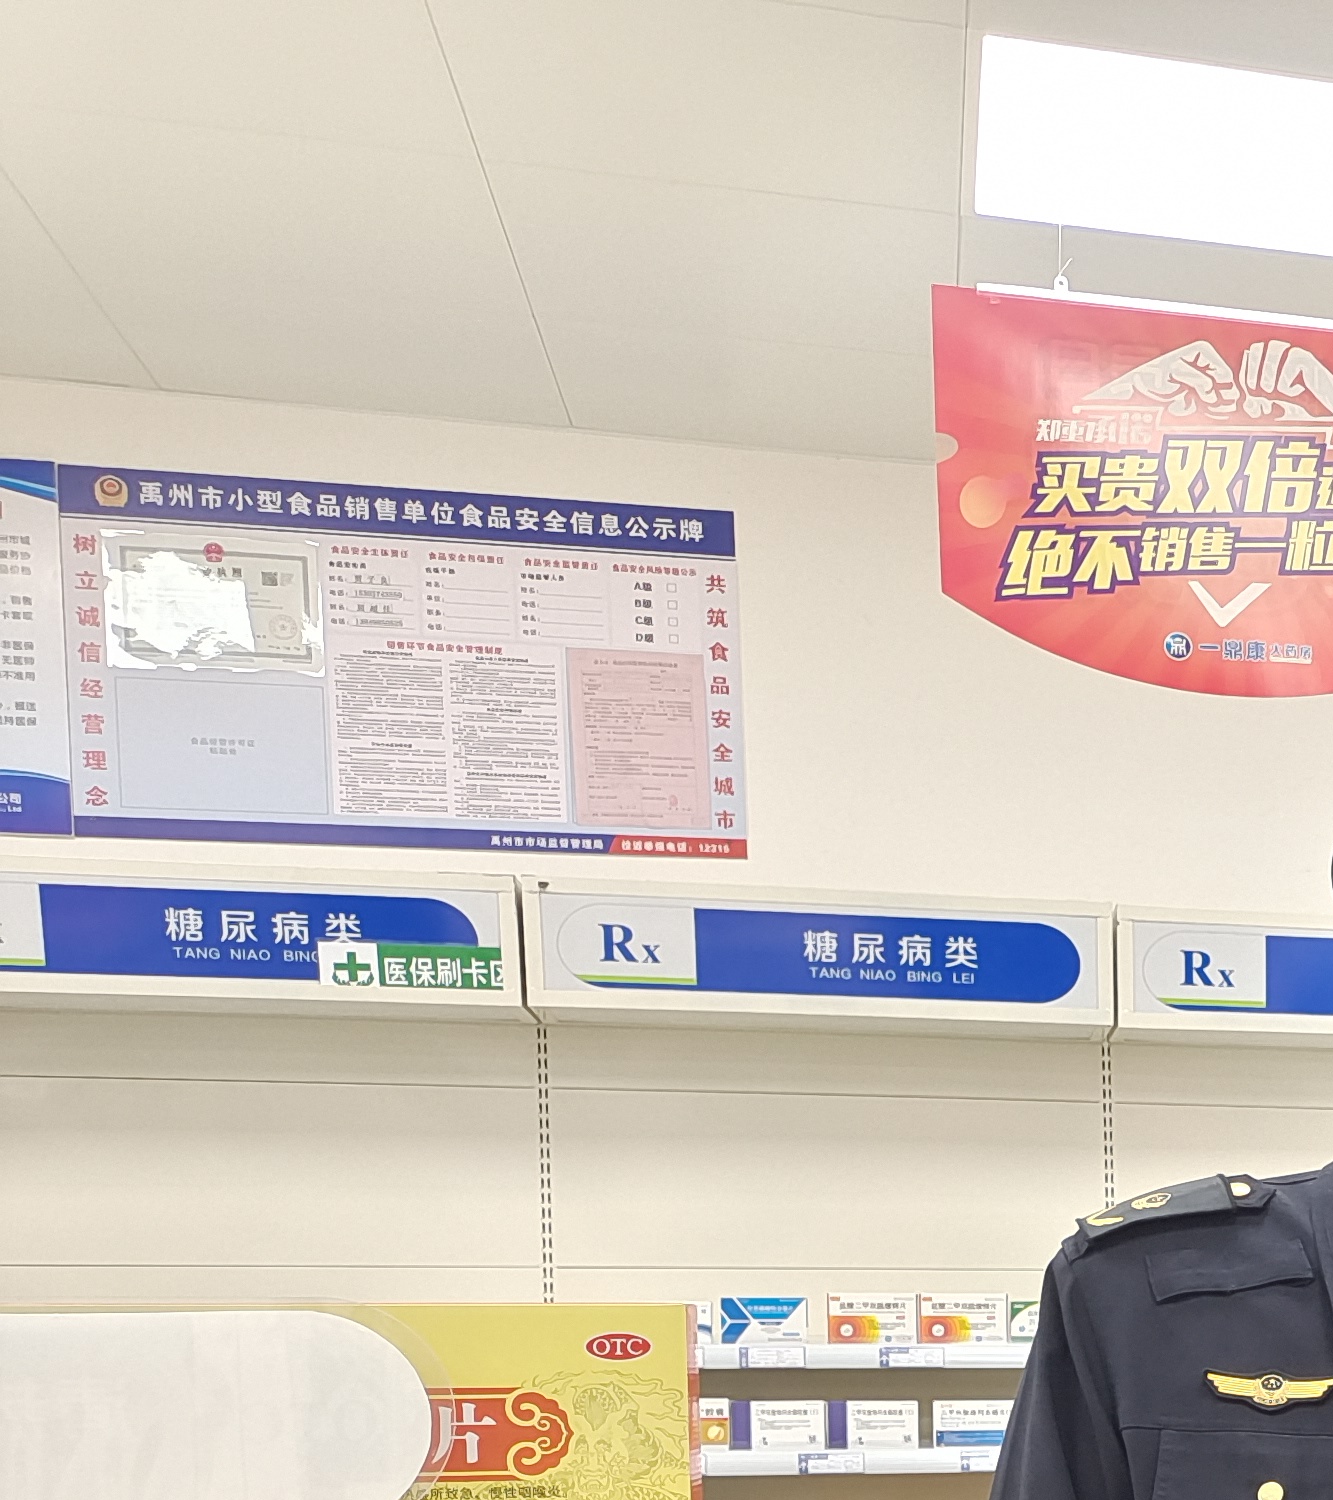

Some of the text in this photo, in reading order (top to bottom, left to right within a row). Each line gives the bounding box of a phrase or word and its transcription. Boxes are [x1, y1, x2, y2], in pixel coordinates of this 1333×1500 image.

[138, 480, 706, 544] 禹州市小型食品销售单位食品安全信息公示牌
[73, 533, 109, 807] 树立诚信经营理念
[705, 574, 736, 829] 共筑食品安全城市
[163, 907, 363, 944] 糖尿病类
[599, 923, 662, 966] Rx
[171, 946, 221, 962] TANG
[229, 948, 272, 962] NIAO
[802, 928, 980, 971] 糖尿病类
[1180, 949, 1236, 989] Rx
[383, 955, 504, 989] 医保刷卡区
[808, 965, 976, 985] TANG NIAO BING LEI
[591, 1337, 645, 1356] OTC
[432, 1403, 498, 1466] 片
